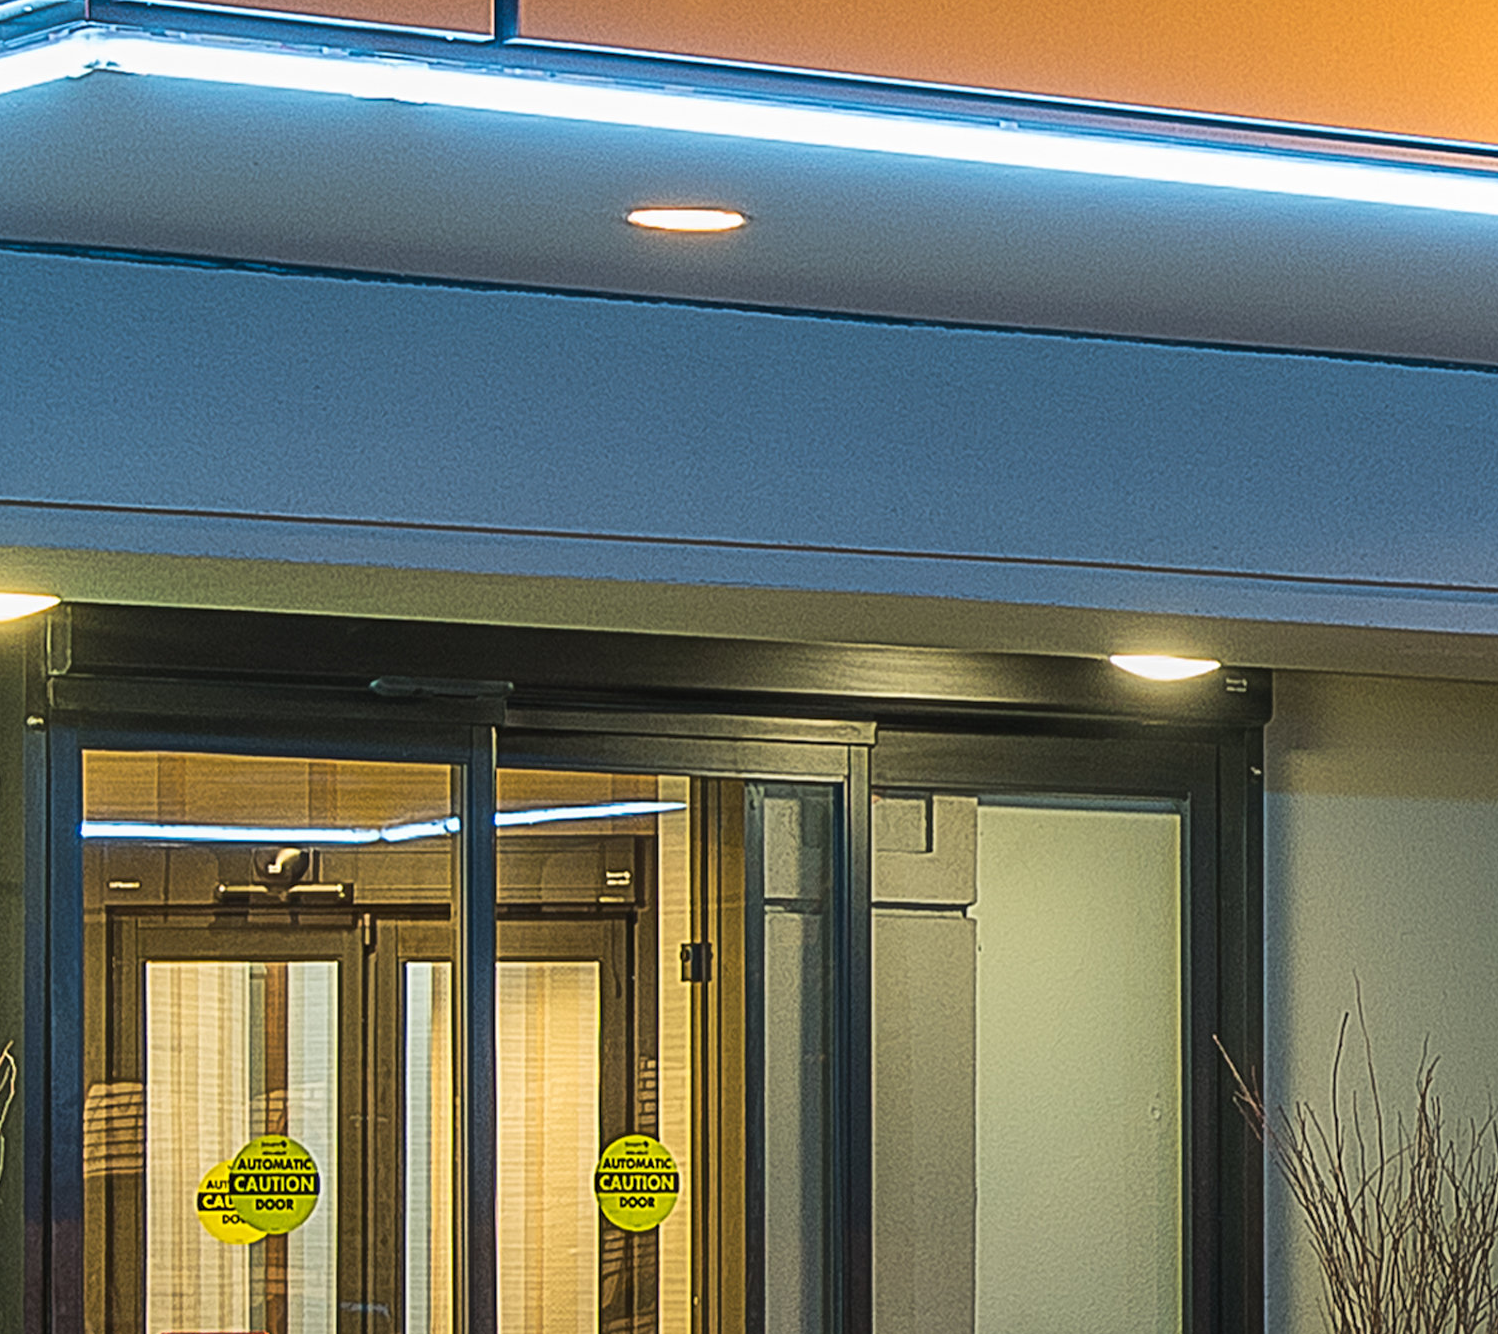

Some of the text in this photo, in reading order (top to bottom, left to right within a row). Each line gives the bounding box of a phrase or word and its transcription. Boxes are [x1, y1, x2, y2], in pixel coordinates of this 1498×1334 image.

[237, 1158, 312, 1170] AUTOMATIC
[603, 1158, 672, 1169] AUTOMATIC
[234, 1175, 315, 1192] CAUTION
[599, 1174, 674, 1190] CAUTION
[255, 1199, 294, 1210] DOOR
[619, 1197, 655, 1208] DOOR
